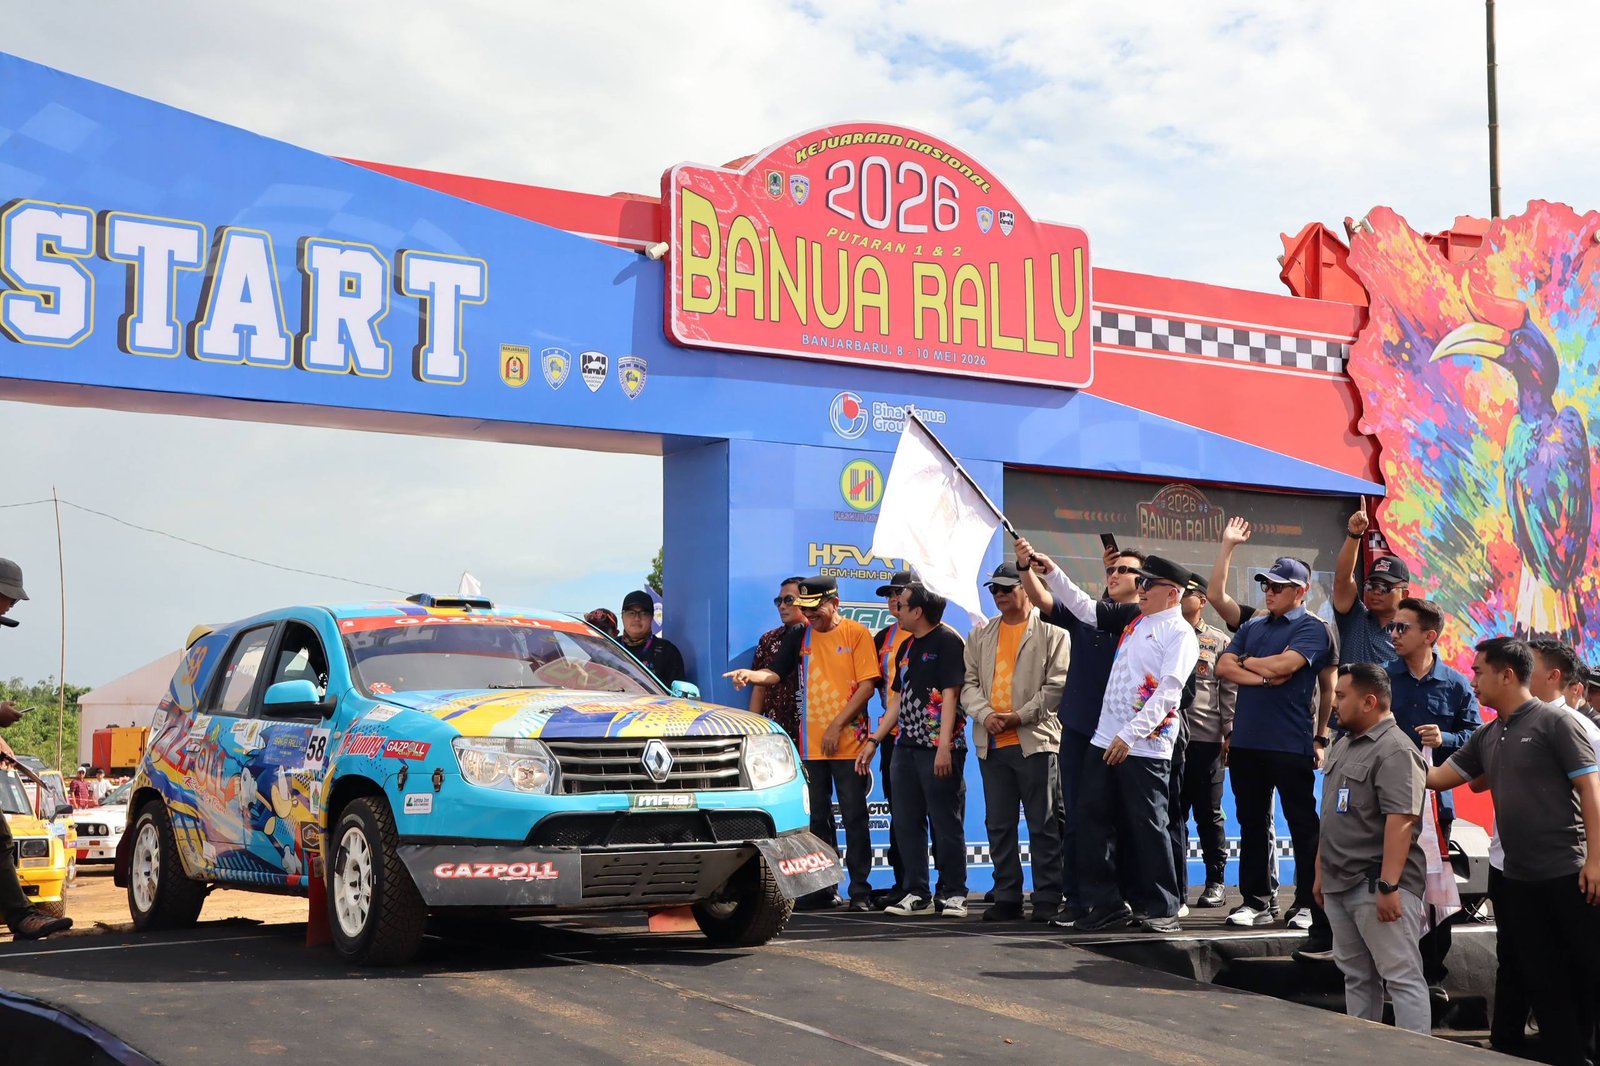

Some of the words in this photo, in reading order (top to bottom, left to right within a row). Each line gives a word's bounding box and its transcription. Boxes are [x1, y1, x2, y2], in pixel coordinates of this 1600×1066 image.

[795, 132, 903, 164] KEJUARAAN
[906, 138, 992, 195] NASIONAL
[826, 155, 960, 234] 2026
[826, 227, 906, 254] PUTARAN
[913, 245, 924, 256] 1
[932, 245, 944, 257] &
[951, 246, 963, 257] 2
[681, 187, 889, 336] BANUA
[912, 247, 1084, 358] RALLY
[1, 199, 488, 385] START
[897, 346, 904, 356] 8
[917, 348, 928, 359] 10
[933, 351, 957, 363] MEI
[961, 354, 986, 366] 2026
[872, 402, 902, 419] Bina
[872, 417, 904, 433] Grou
[1167, 494, 1196, 513] 2026
[1140, 507, 1182, 541] BANUA
[1186, 513, 1222, 544] RALLY
[394, 615, 552, 629] GAZPOLL
[307, 735, 326, 762] 58
[387, 741, 425, 755] GAZPOLL
[434, 862, 559, 878] GAZPOLL
[779, 850, 834, 877] GAZPOLL
